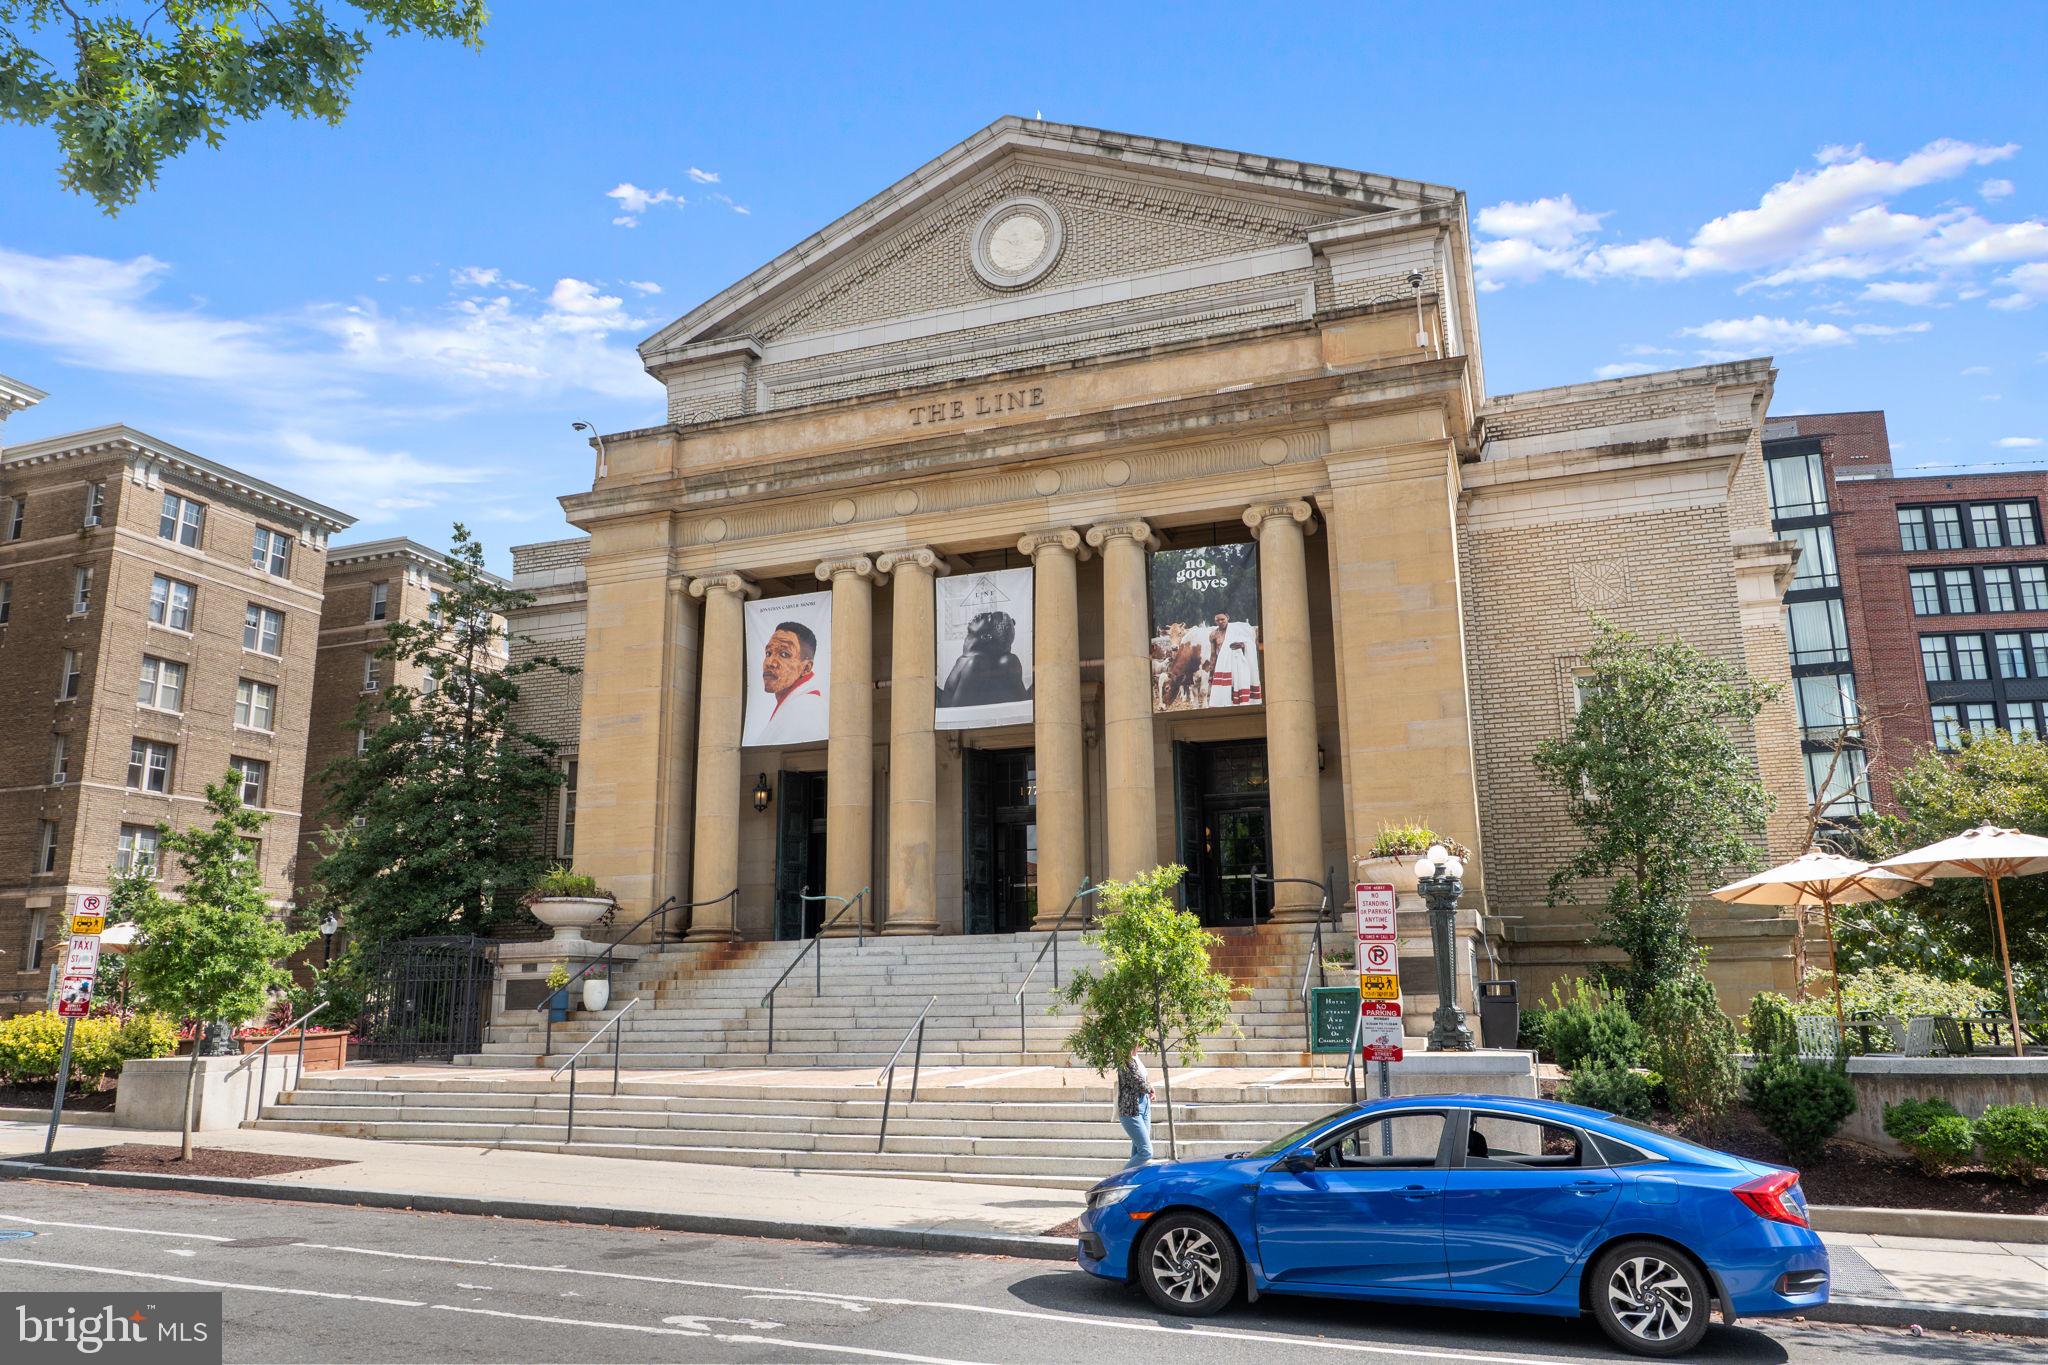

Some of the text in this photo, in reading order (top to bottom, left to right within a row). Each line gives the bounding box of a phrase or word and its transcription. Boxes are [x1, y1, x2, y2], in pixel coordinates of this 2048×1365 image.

[909, 387, 1045, 426] THE LINE
[1184, 558, 1206, 569] no
[1176, 564, 1217, 584] good
[1191, 577, 1228, 592] byes
[73, 940, 93, 950] TAXI
